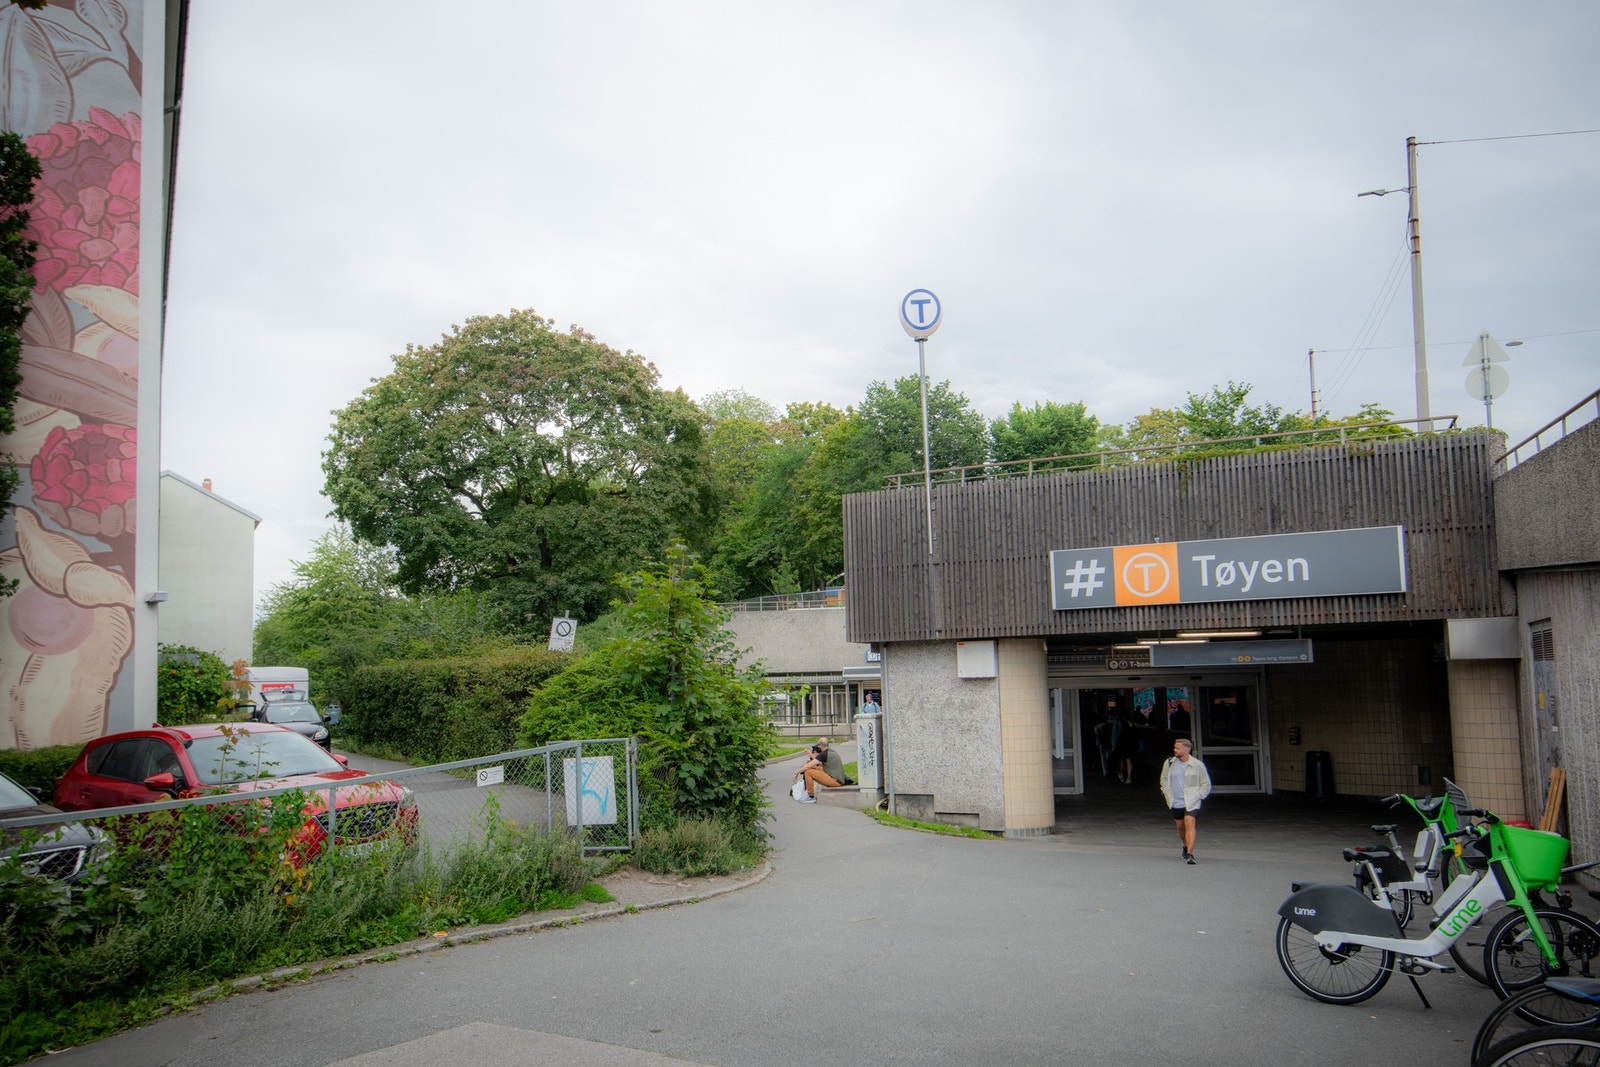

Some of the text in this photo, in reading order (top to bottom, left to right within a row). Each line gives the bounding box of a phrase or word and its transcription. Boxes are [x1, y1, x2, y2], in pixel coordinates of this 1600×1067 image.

[910, 299, 931, 323] T
[1192, 555, 1309, 593] Tøyen
[1129, 660, 1150, 669] T-ban
[1294, 906, 1317, 916] Lime
[1438, 898, 1482, 938] Lime
